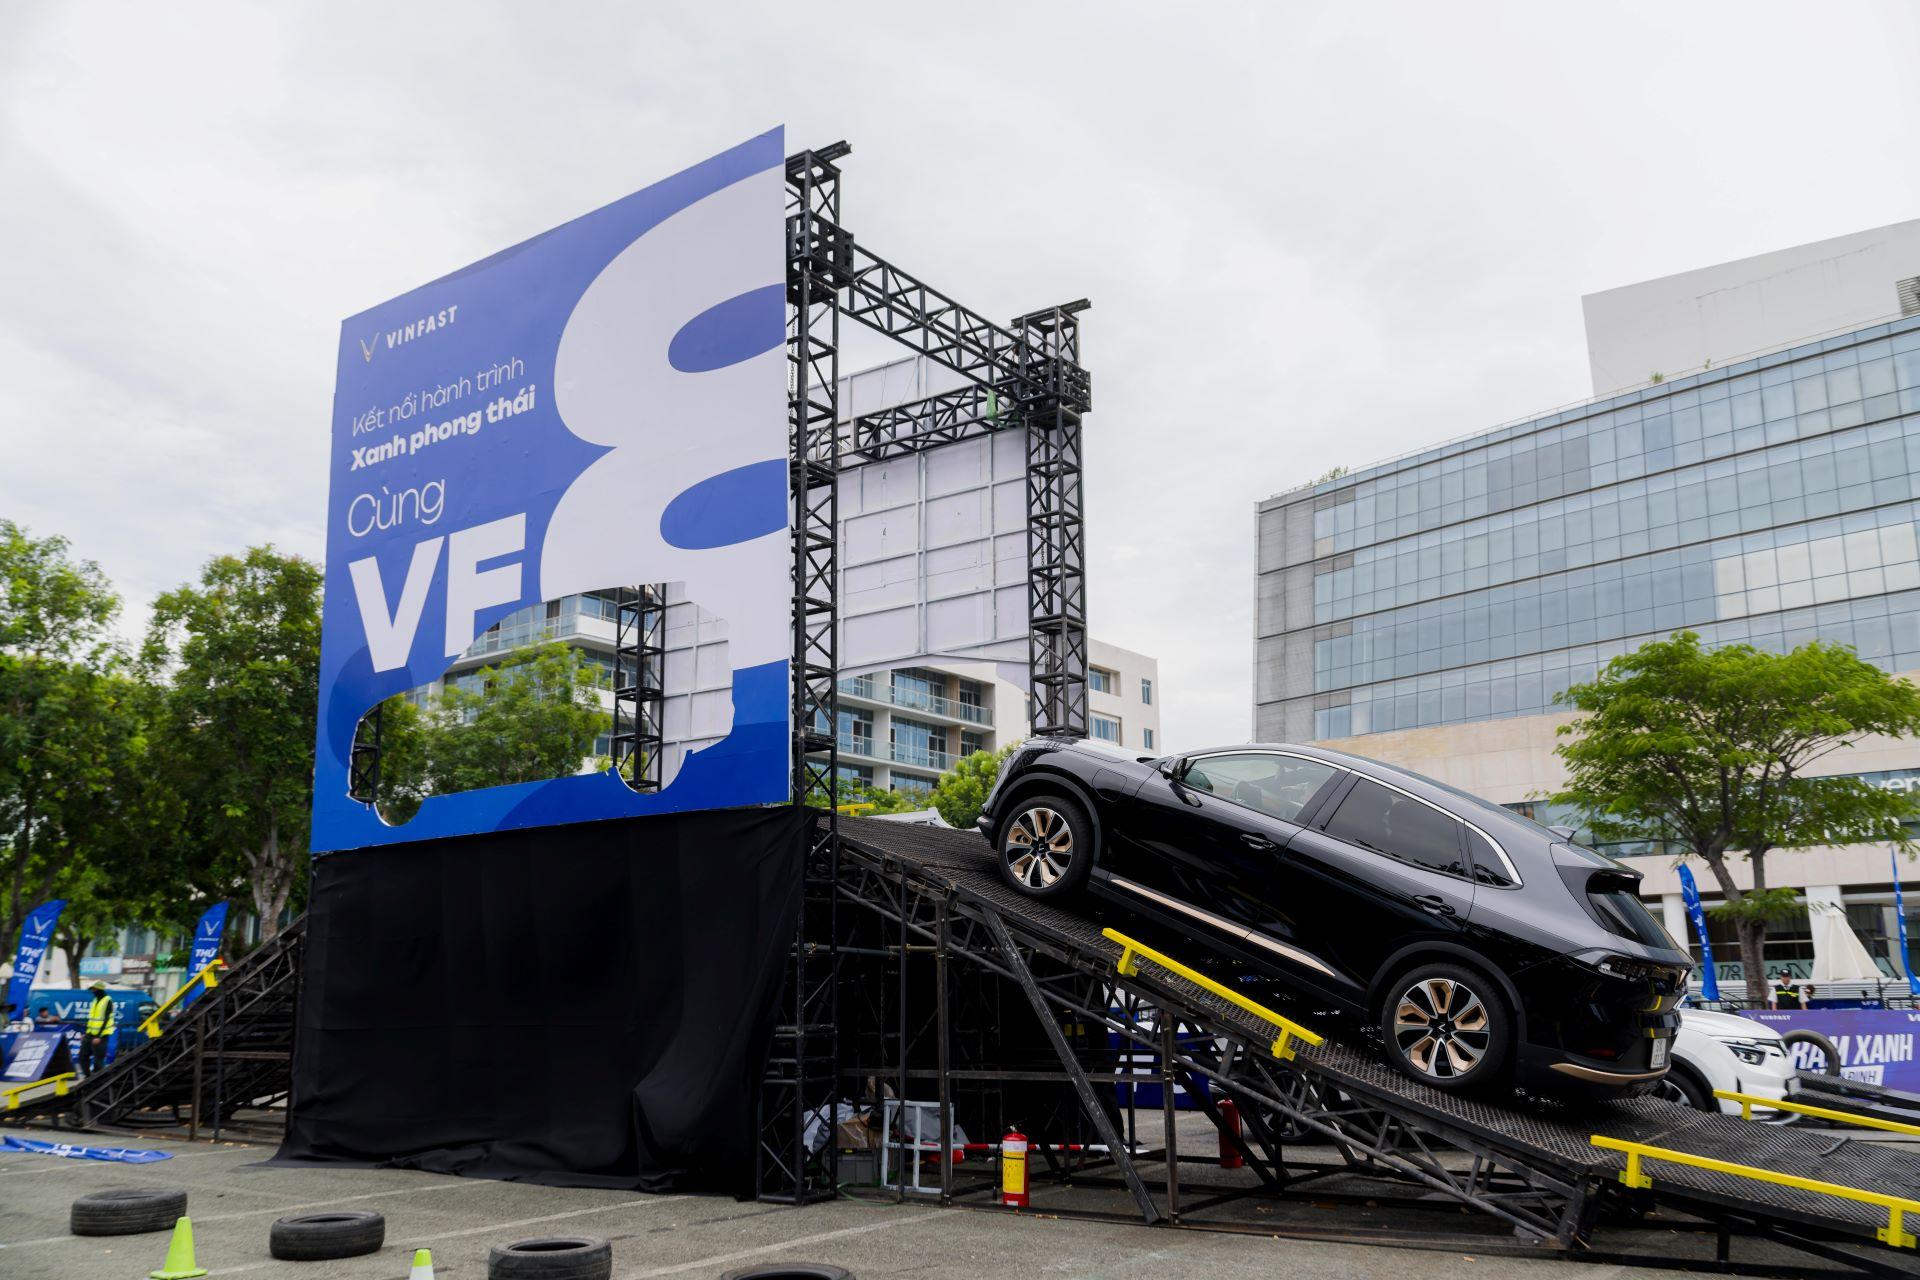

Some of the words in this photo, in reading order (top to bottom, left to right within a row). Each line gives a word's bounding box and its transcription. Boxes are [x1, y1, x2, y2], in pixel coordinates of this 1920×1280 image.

[386, 305, 458, 349] VINFAST
[350, 435, 407, 471] Xanh
[409, 410, 483, 455] phong
[486, 384, 537, 424] thái
[352, 406, 386, 437] Kết
[388, 391, 418, 424] nối
[420, 376, 472, 412] hành
[476, 356, 525, 391] trình
[348, 479, 446, 537] Cùng
[348, 512, 526, 673] VF
[1853, 1033, 1914, 1065] XANH
